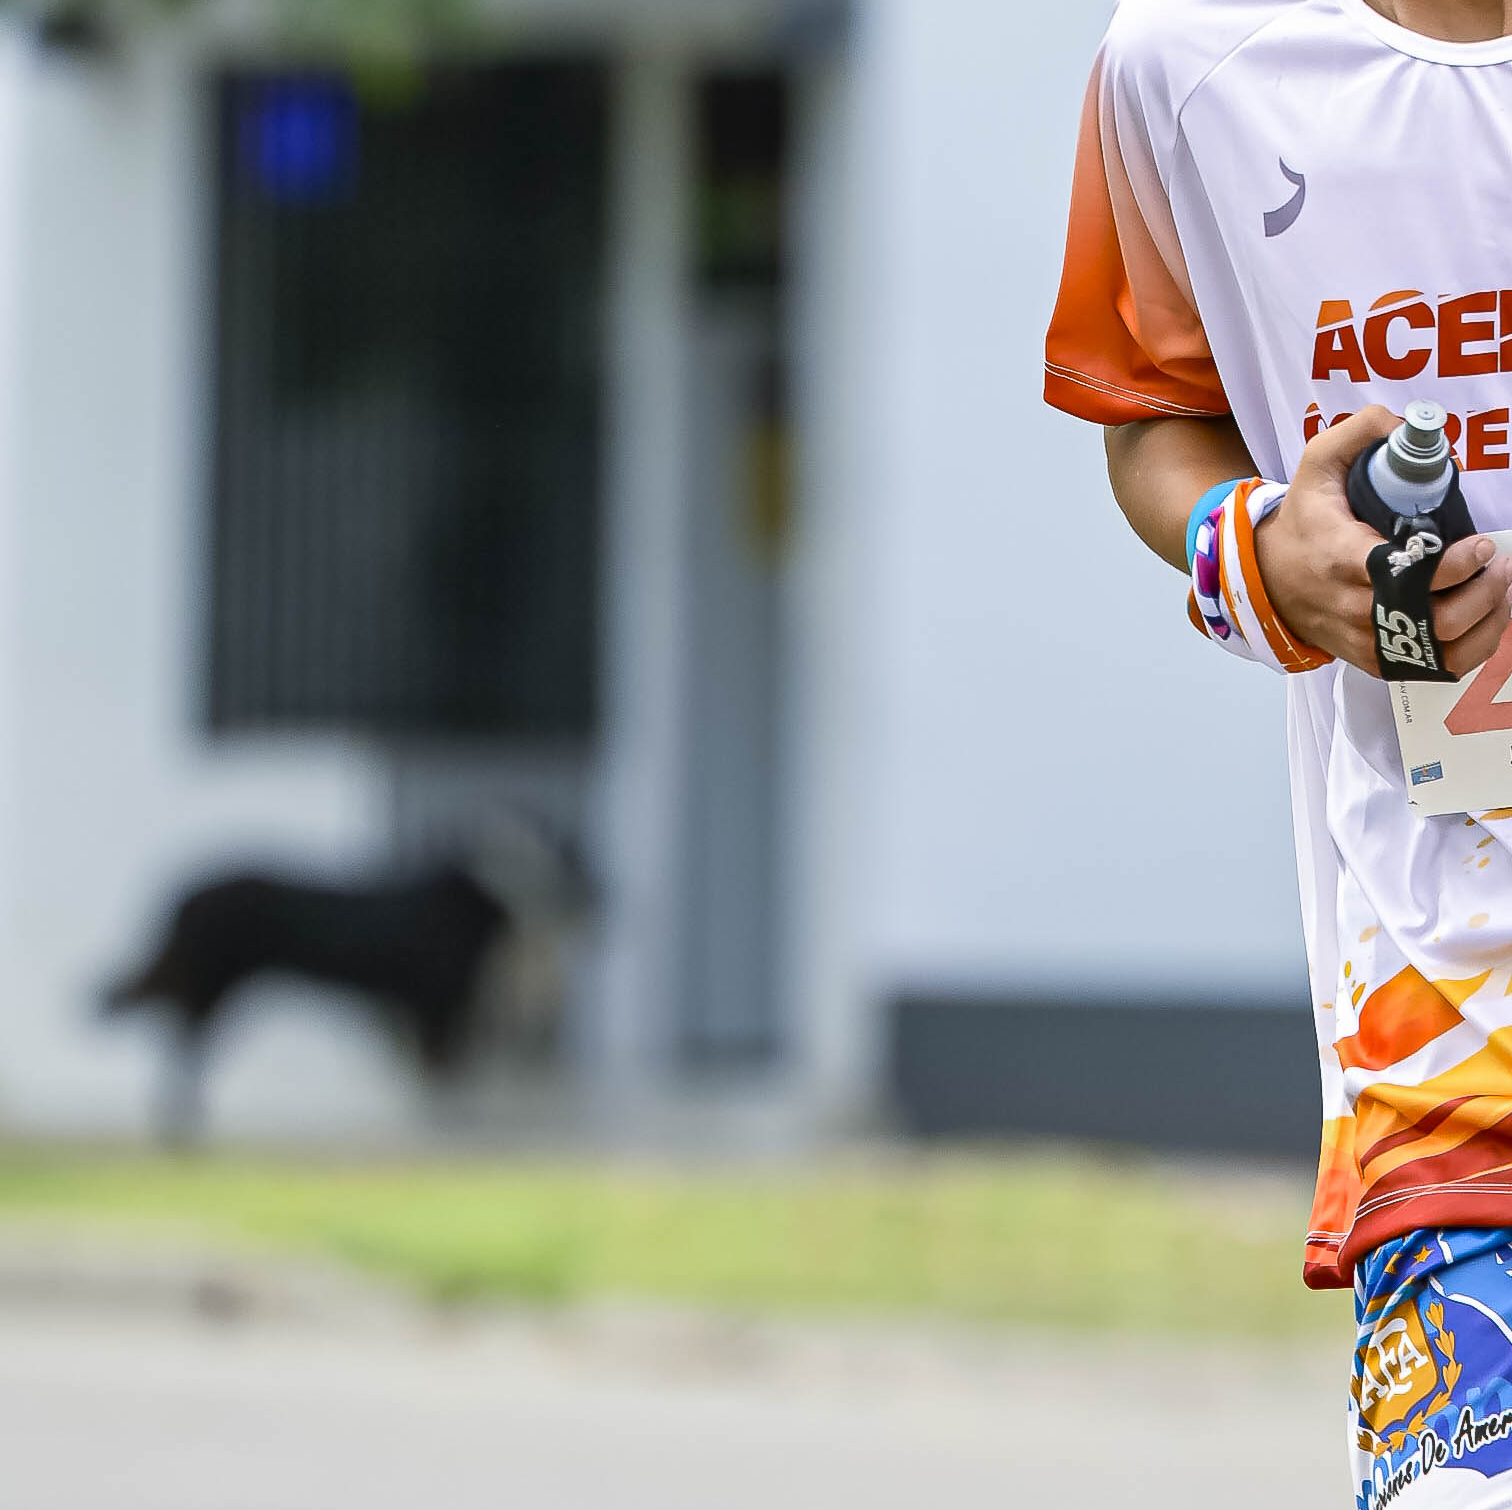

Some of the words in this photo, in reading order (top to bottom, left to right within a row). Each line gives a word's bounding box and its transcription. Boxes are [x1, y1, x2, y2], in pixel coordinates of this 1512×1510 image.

[1376, 603, 1427, 668] 155
[1360, 1317, 1428, 1412] AFA
[1421, 1432, 1447, 1476] De
